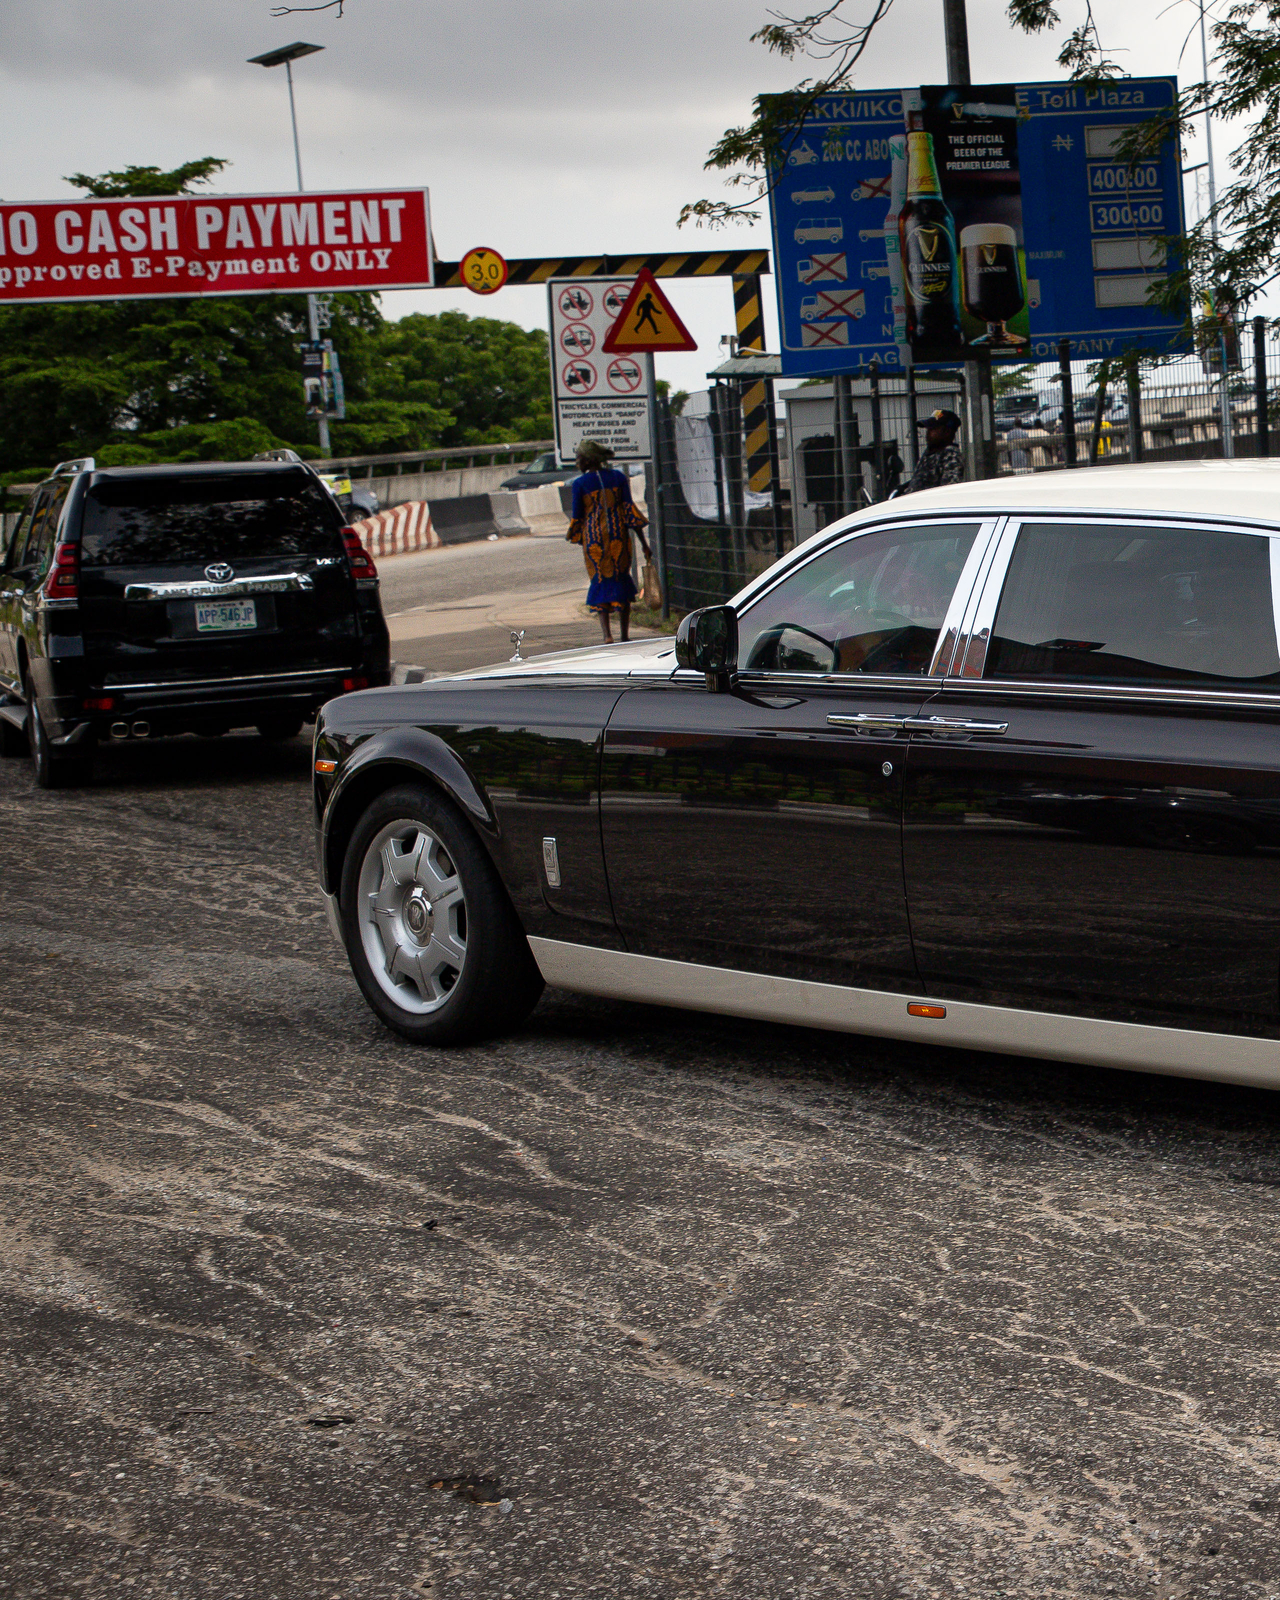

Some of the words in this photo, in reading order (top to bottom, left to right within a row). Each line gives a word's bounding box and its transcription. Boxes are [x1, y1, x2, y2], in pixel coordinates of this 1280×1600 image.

[1037, 89, 1077, 109] Toll
[1085, 87, 1145, 107] Plaza
[948, 135, 965, 144] THE
[966, 134, 1005, 144] OFFICIAL
[845, 139, 862, 161] CC
[954, 148, 976, 157] BEER
[977, 148, 987, 157] OF
[988, 147, 1003, 156] THE
[946, 161, 981, 171] PREMIER
[981, 160, 1010, 170] LEAGUE
[1097, 205, 1163, 226] 300:00
[54, 207, 180, 255] CASH
[195, 199, 406, 250] PAYMENT
[130, 252, 300, 282] E-Payment
[310, 248, 392, 272] ONLY
[471, 264, 500, 281] 3.0
[908, 262, 951, 273] GUINNESS
